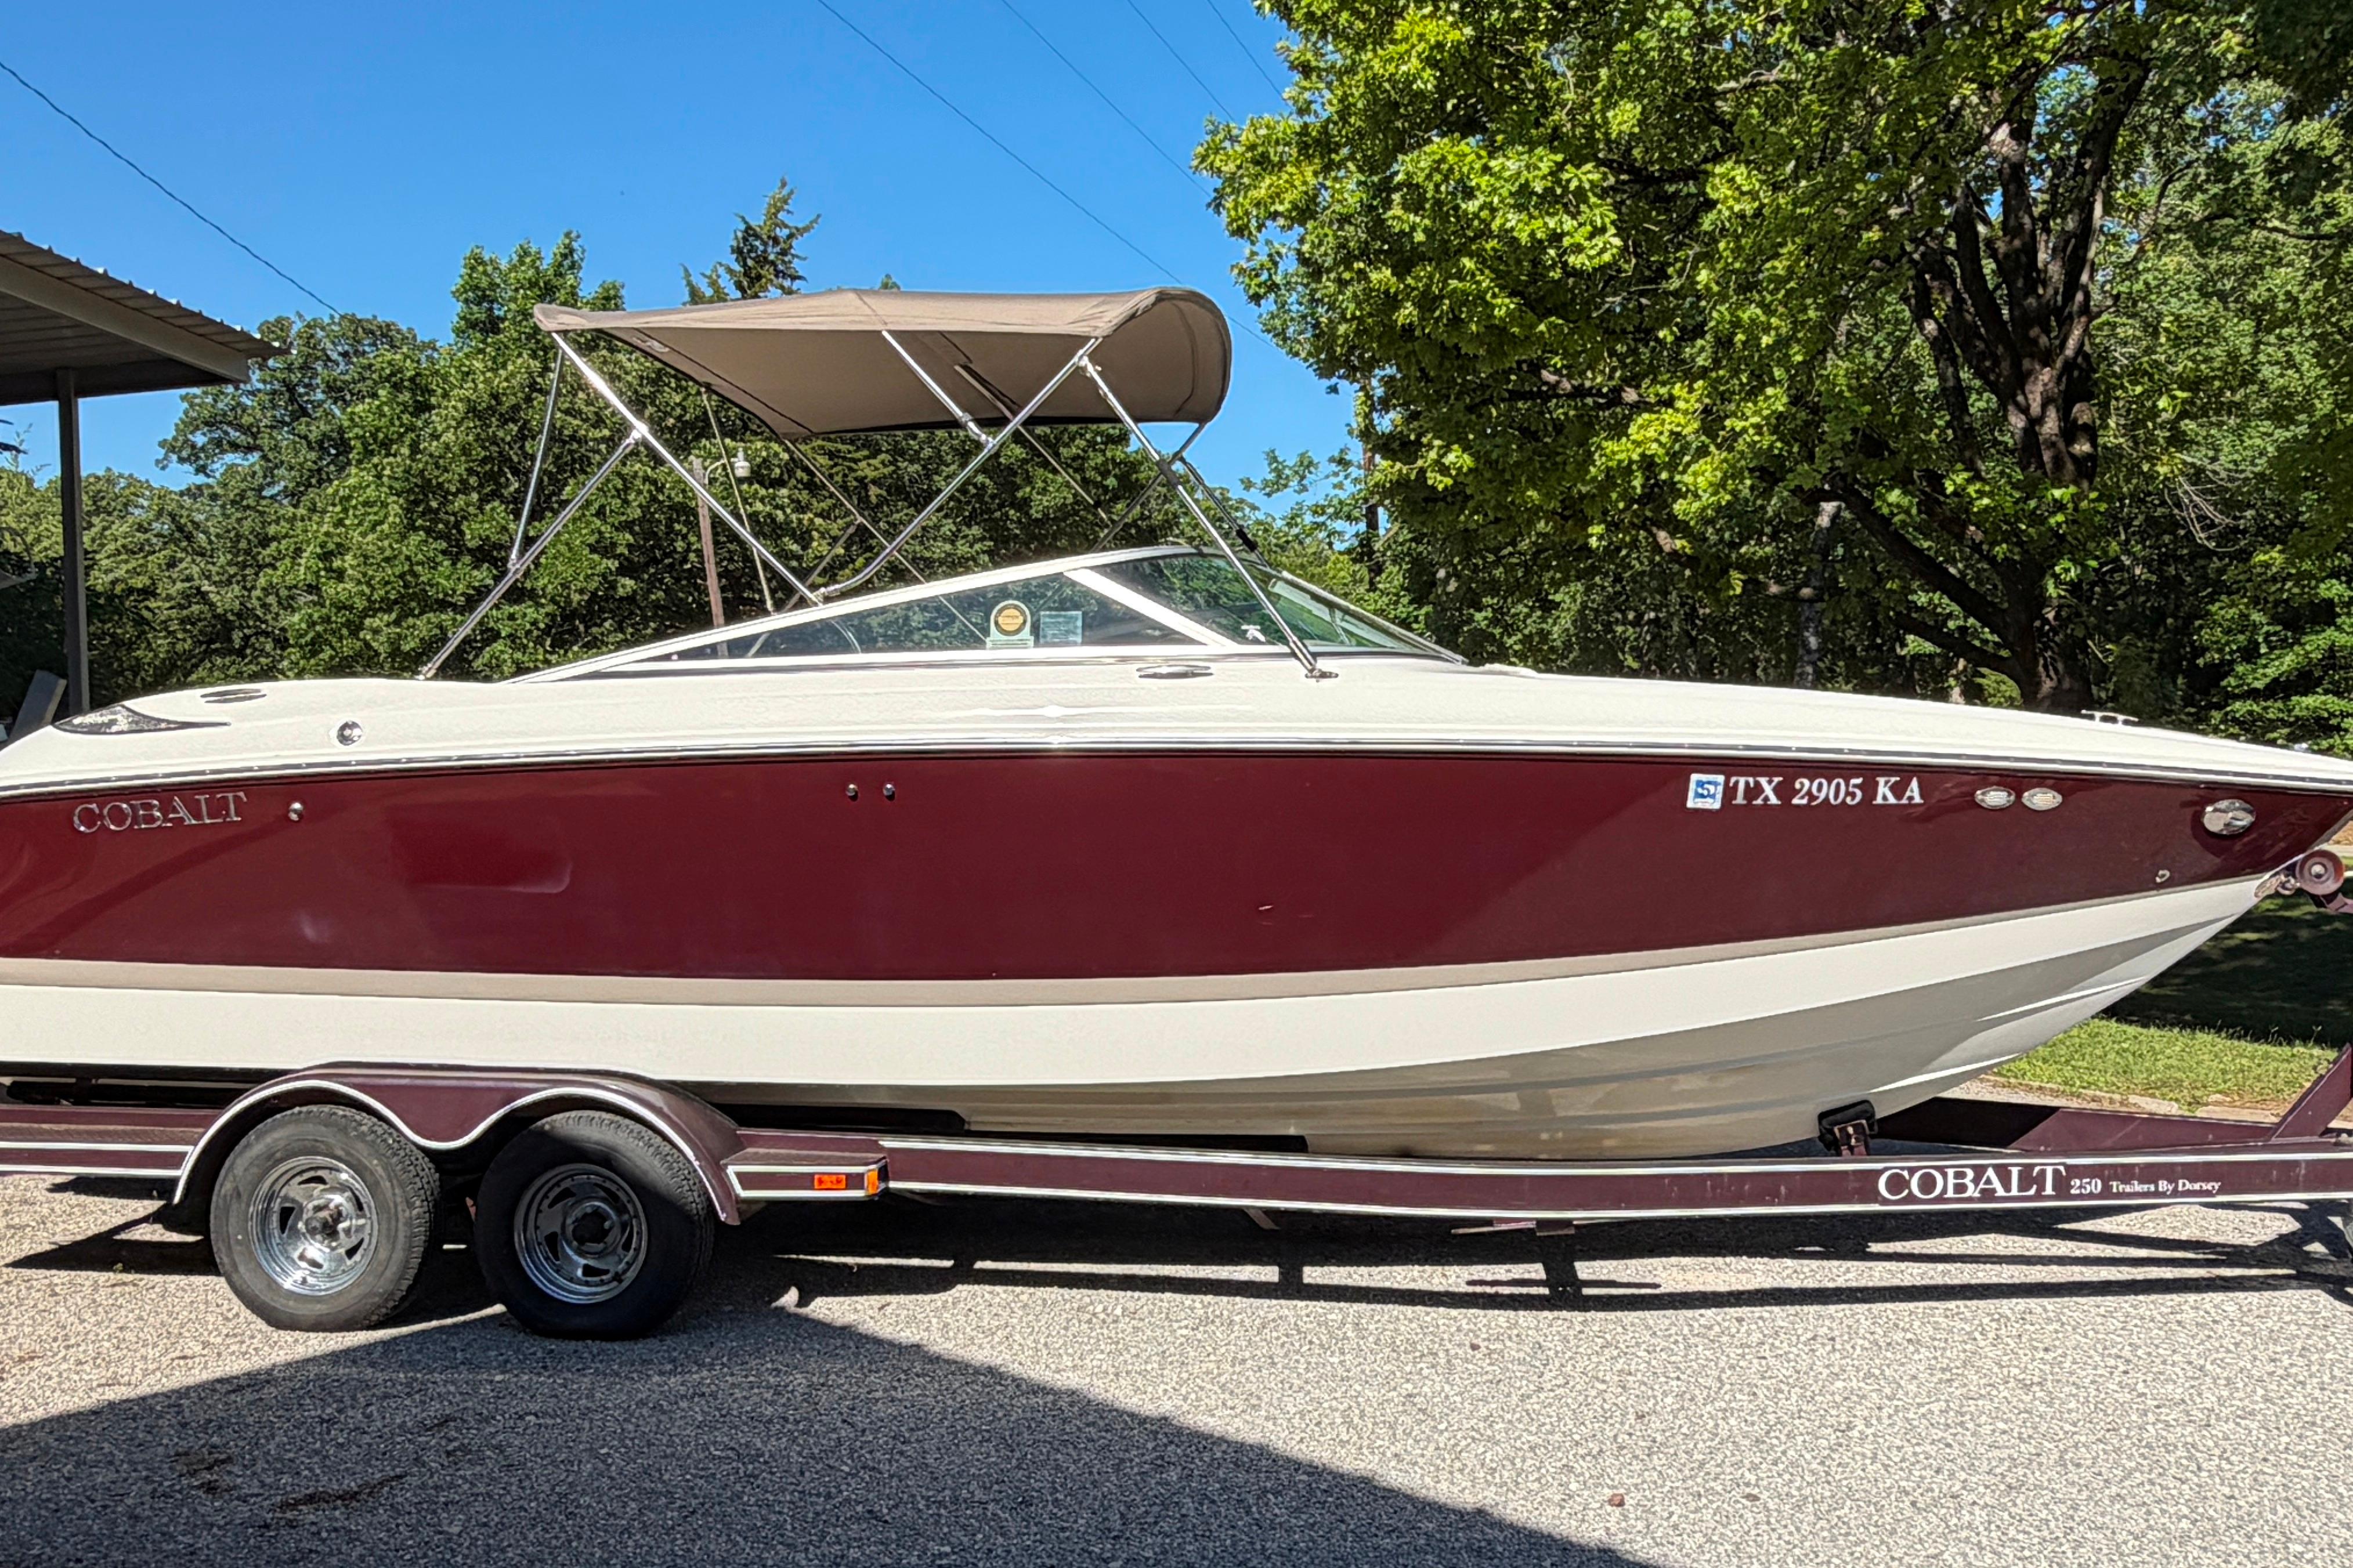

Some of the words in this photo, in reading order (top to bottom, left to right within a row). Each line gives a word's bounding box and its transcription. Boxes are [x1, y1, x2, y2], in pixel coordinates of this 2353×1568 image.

[1729, 776, 1783, 805] TX
[1791, 777, 1864, 806] 2905
[1872, 776, 1925, 806] KA
[73, 791, 248, 834] COBALT
[1877, 1165, 2067, 1201] COBALT
[2069, 1178, 2102, 1195] 250
[2109, 1180, 2155, 1193] Trailers
[2158, 1179, 2175, 1195] By
[2178, 1179, 2222, 1194] Dorsey
